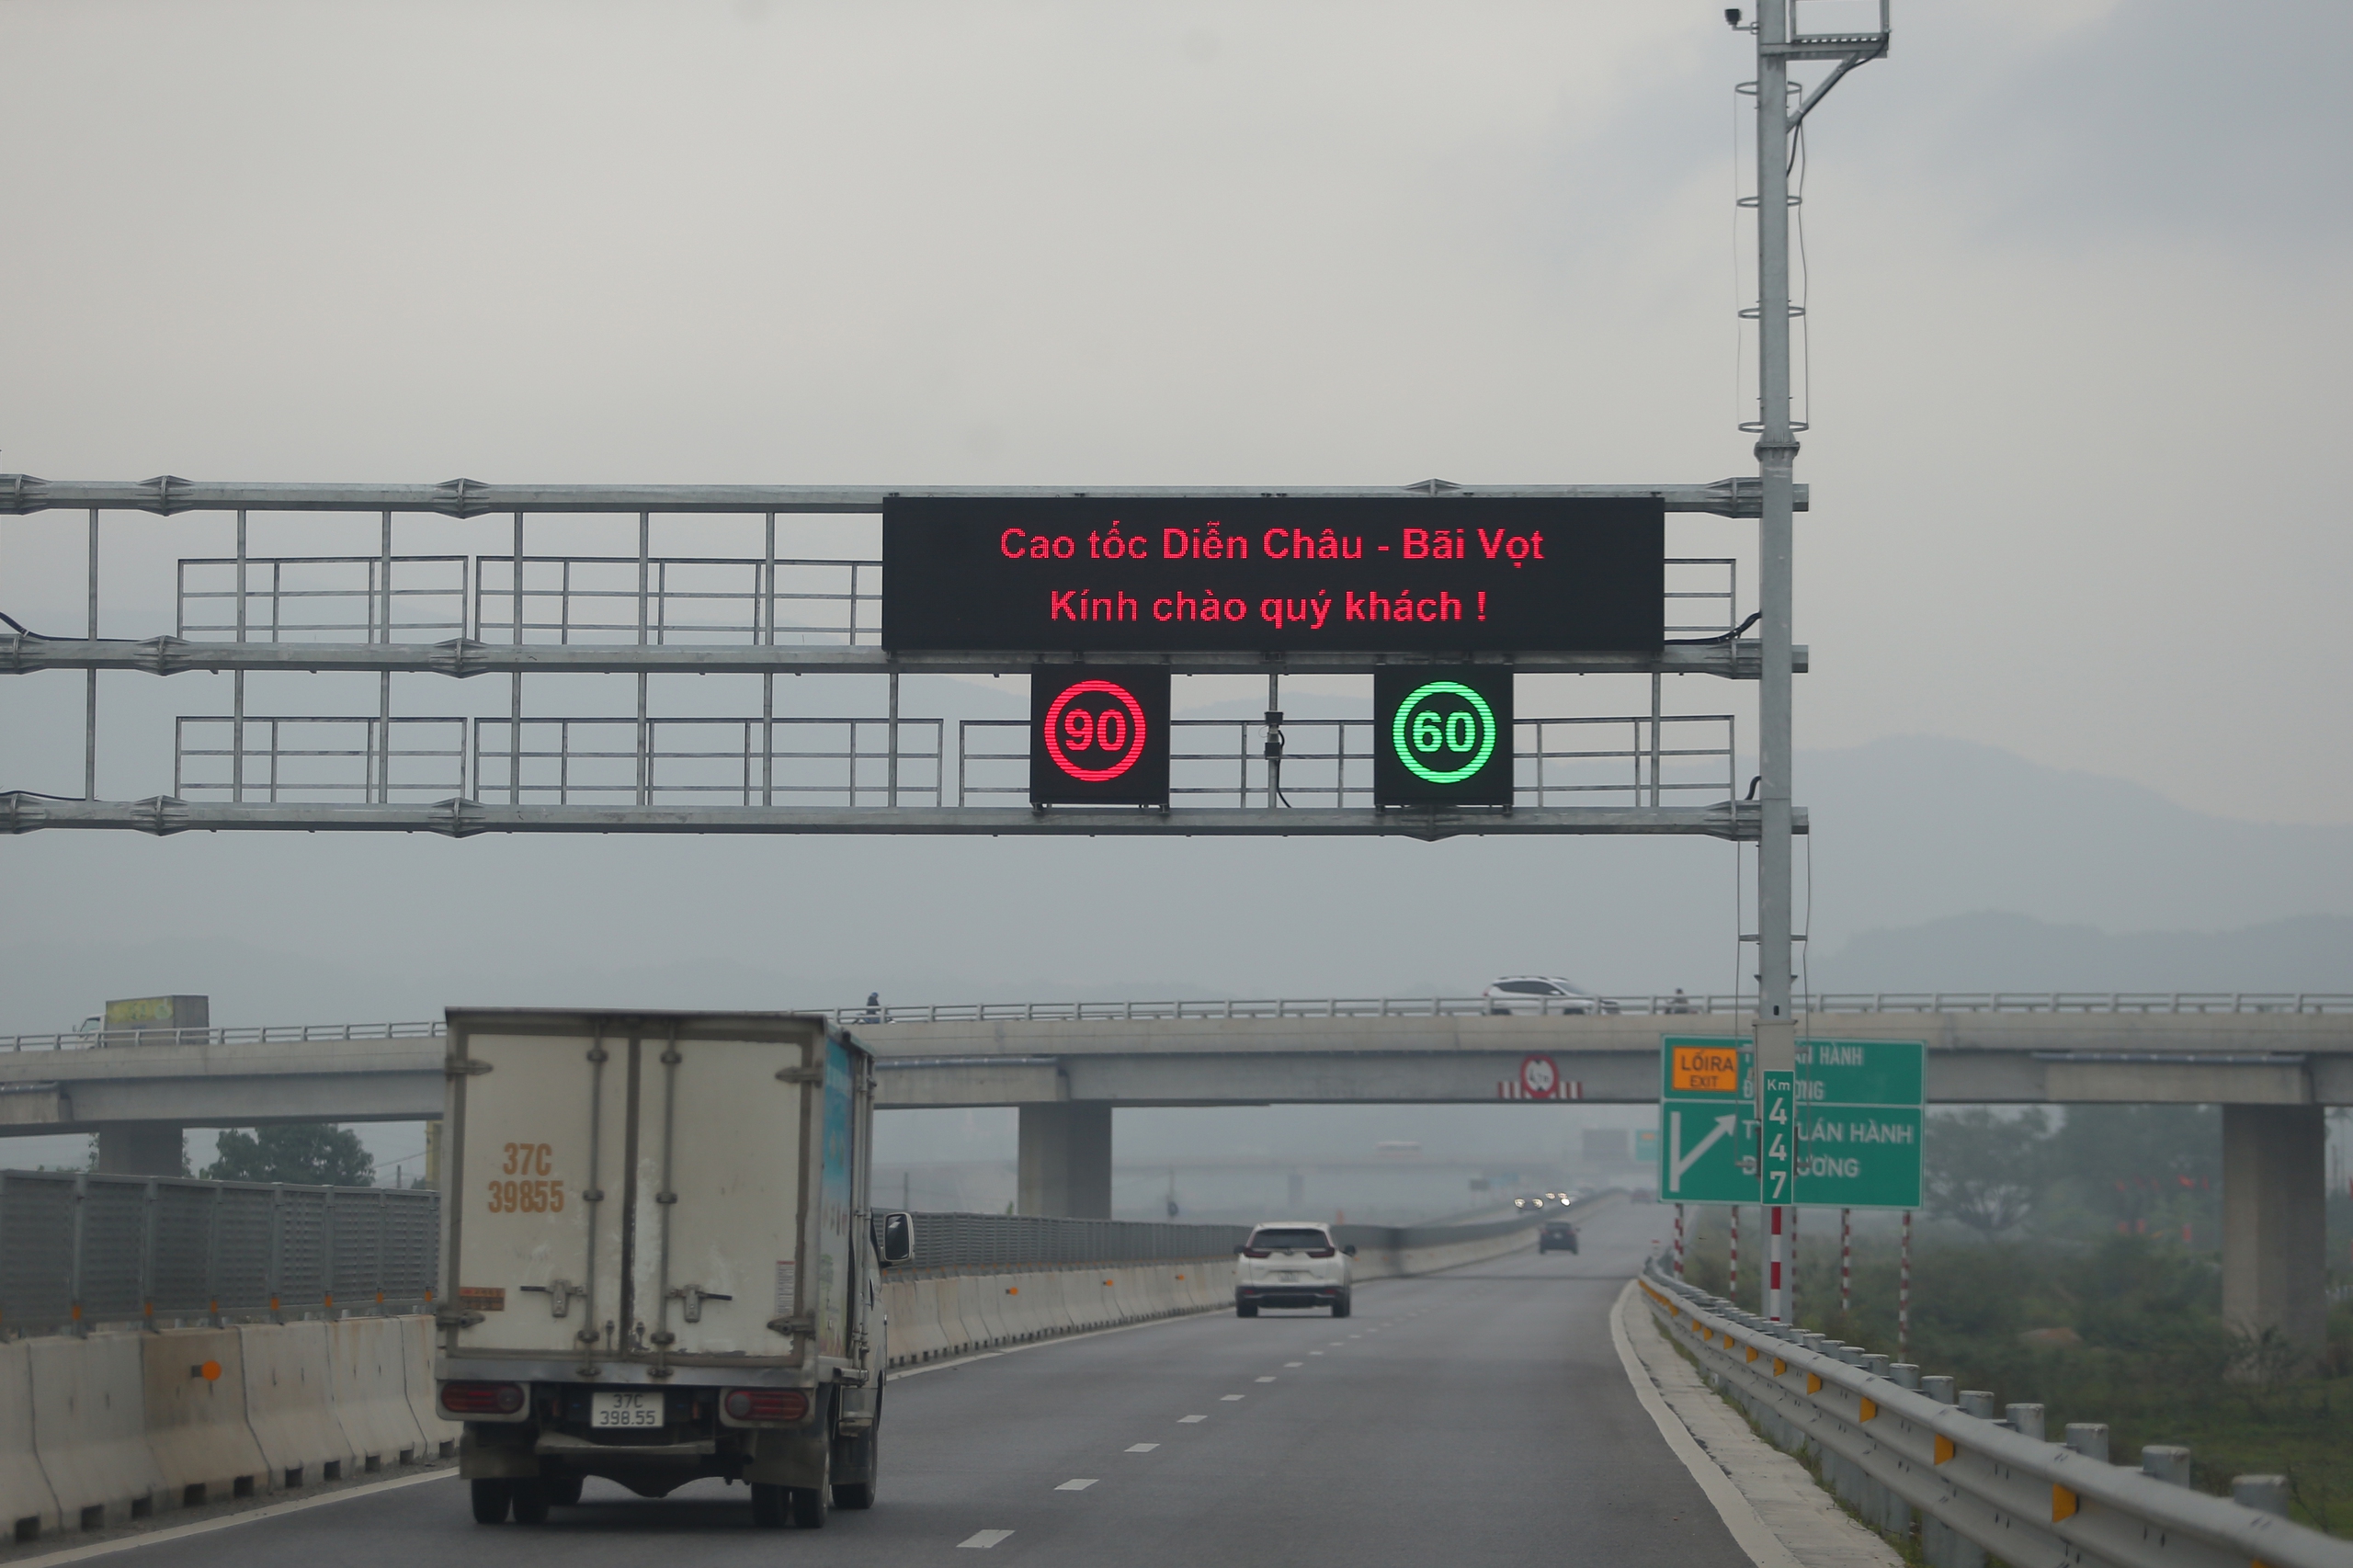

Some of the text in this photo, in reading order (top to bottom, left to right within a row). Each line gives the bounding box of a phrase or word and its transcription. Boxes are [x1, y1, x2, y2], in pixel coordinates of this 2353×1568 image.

[1000, 527, 1076, 560] Cao
[1086, 520, 1149, 560] tốc
[1163, 520, 1249, 560] Diễn
[1262, 527, 1363, 560] Châu
[1402, 527, 1466, 560] Bãi
[1476, 527, 1545, 569] Vọt
[1051, 588, 1139, 622] Kính
[1152, 588, 1248, 622] chào
[1258, 588, 1334, 631] quý
[1345, 588, 1463, 623] khách
[1063, 708, 1127, 752] 90
[1412, 710, 1477, 753] 60
[1819, 1040, 1864, 1066] HÀNH
[1689, 1074, 1719, 1088] EXIT
[1767, 1077, 1791, 1092] Km
[1797, 1117, 1843, 1142] UÁN
[1849, 1118, 1915, 1145] HÀNH
[503, 1142, 552, 1176] 37C
[487, 1179, 565, 1213] 39855
[613, 1393, 643, 1409] 37C
[599, 1410, 656, 1426] 398.55
